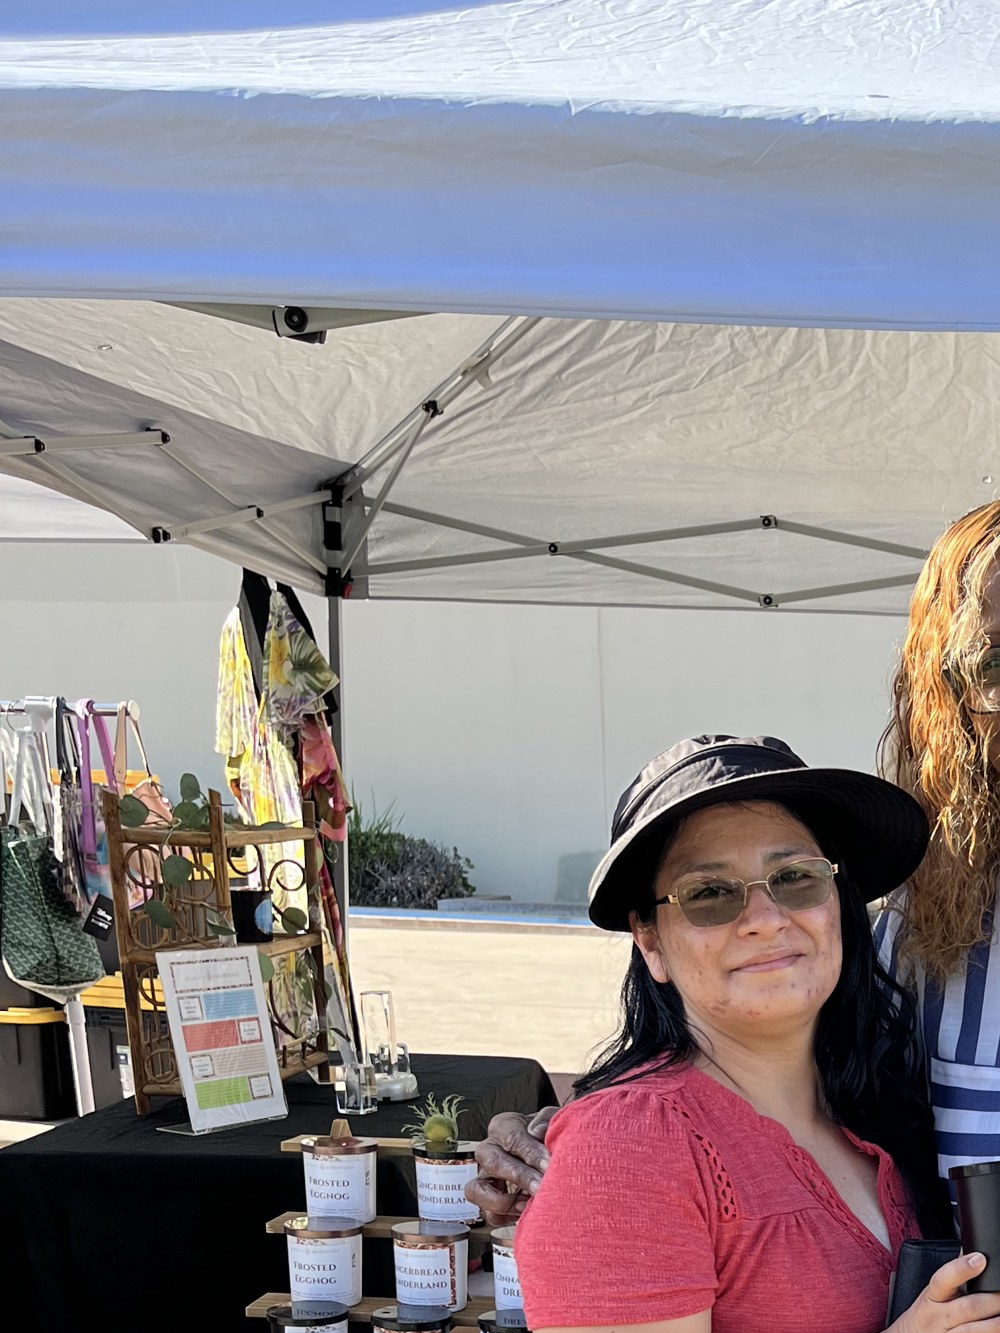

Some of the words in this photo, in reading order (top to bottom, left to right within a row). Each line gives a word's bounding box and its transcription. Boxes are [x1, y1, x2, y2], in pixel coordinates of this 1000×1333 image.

[309, 1176, 350, 1186] FROSTED
[310, 1190, 350, 1200] EGGNOG
[294, 1262, 336, 1271] FROSTED
[296, 1274, 336, 1284] EGGNOG
